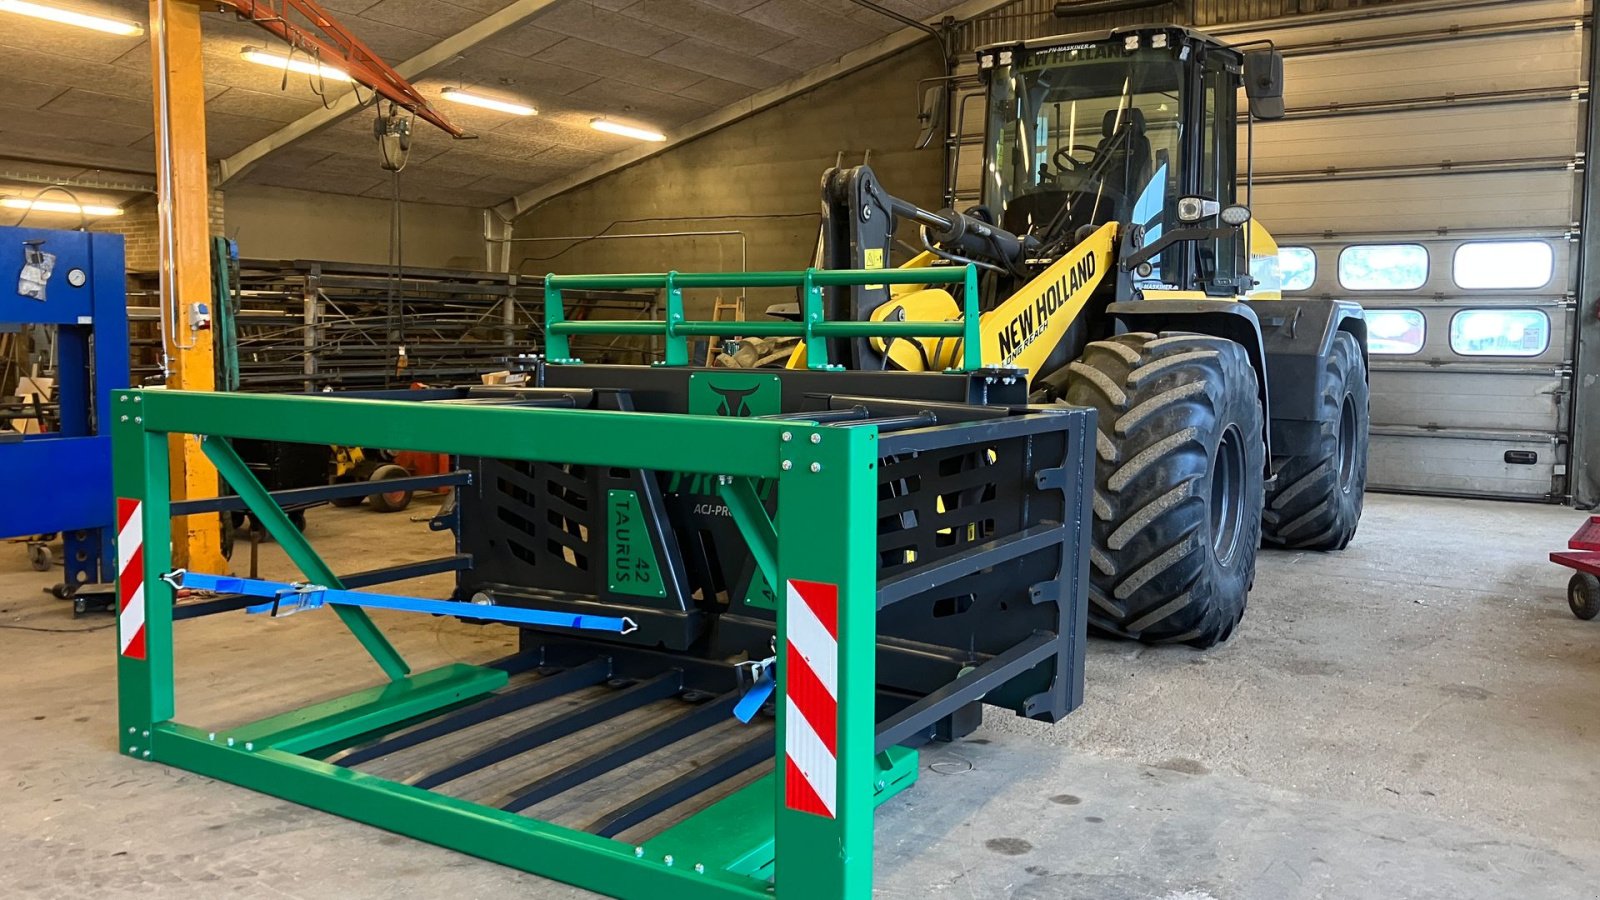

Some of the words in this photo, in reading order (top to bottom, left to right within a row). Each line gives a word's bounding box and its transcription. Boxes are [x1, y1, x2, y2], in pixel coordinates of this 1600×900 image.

[998, 304, 1033, 360] NEW
[1036, 250, 1096, 326] HOLLAND
[1024, 320, 1049, 349] REACH
[615, 500, 630, 583] TAURUS
[635, 557, 650, 583] 42
